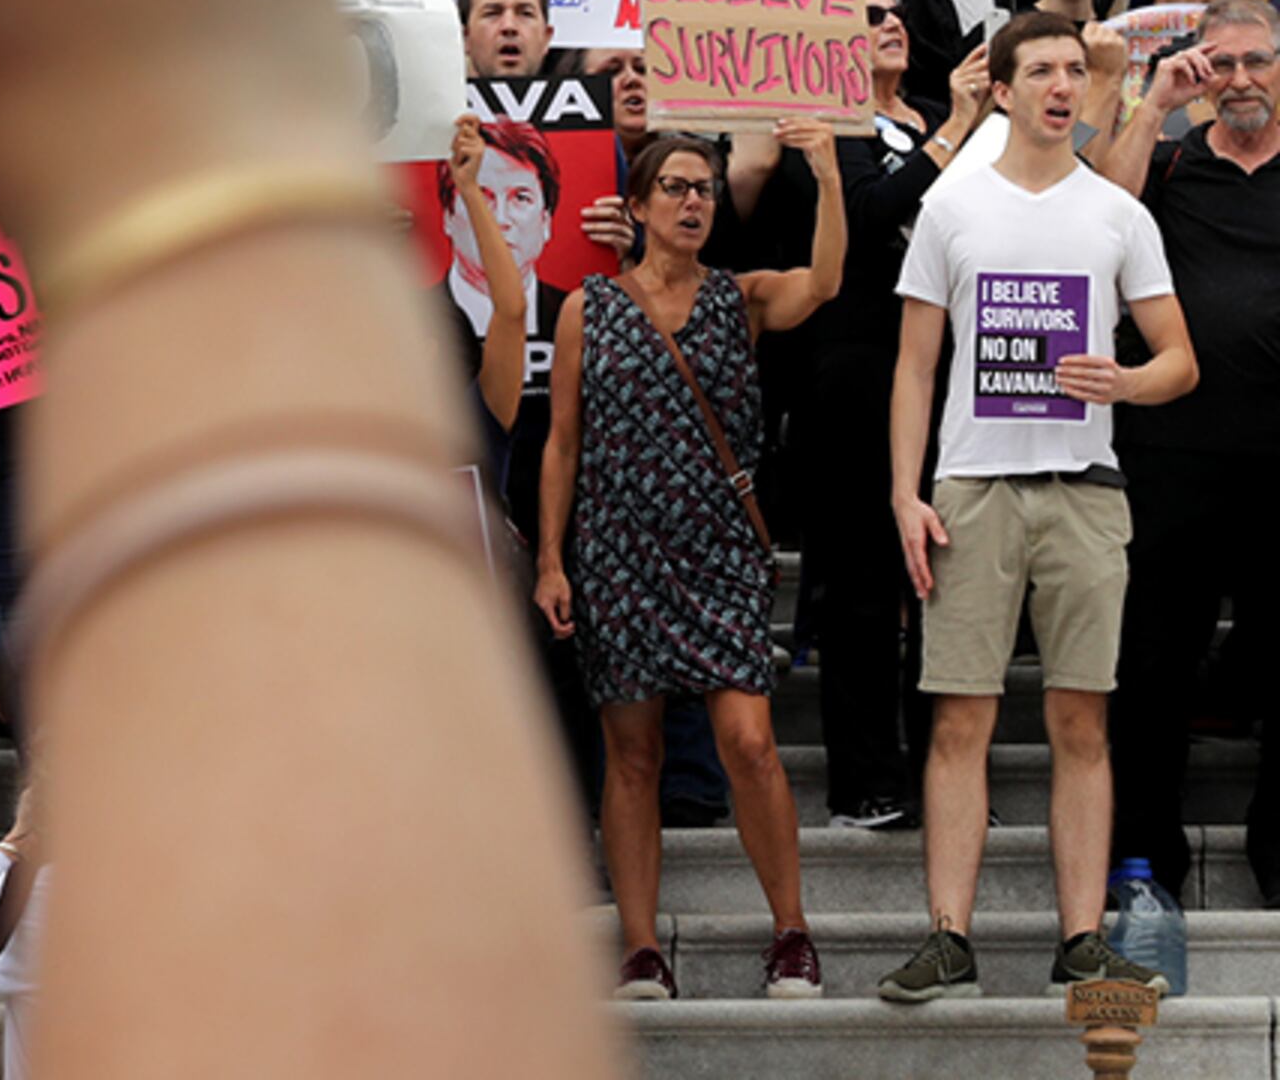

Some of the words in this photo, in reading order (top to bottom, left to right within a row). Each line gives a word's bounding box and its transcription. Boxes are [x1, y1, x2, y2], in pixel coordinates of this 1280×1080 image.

[646, 21, 870, 106] SURVIVORS
[981, 280, 988, 302] I
[991, 280, 1061, 305] BELIEVE
[981, 335, 1007, 361] NO
[1010, 337, 1037, 362] ON
